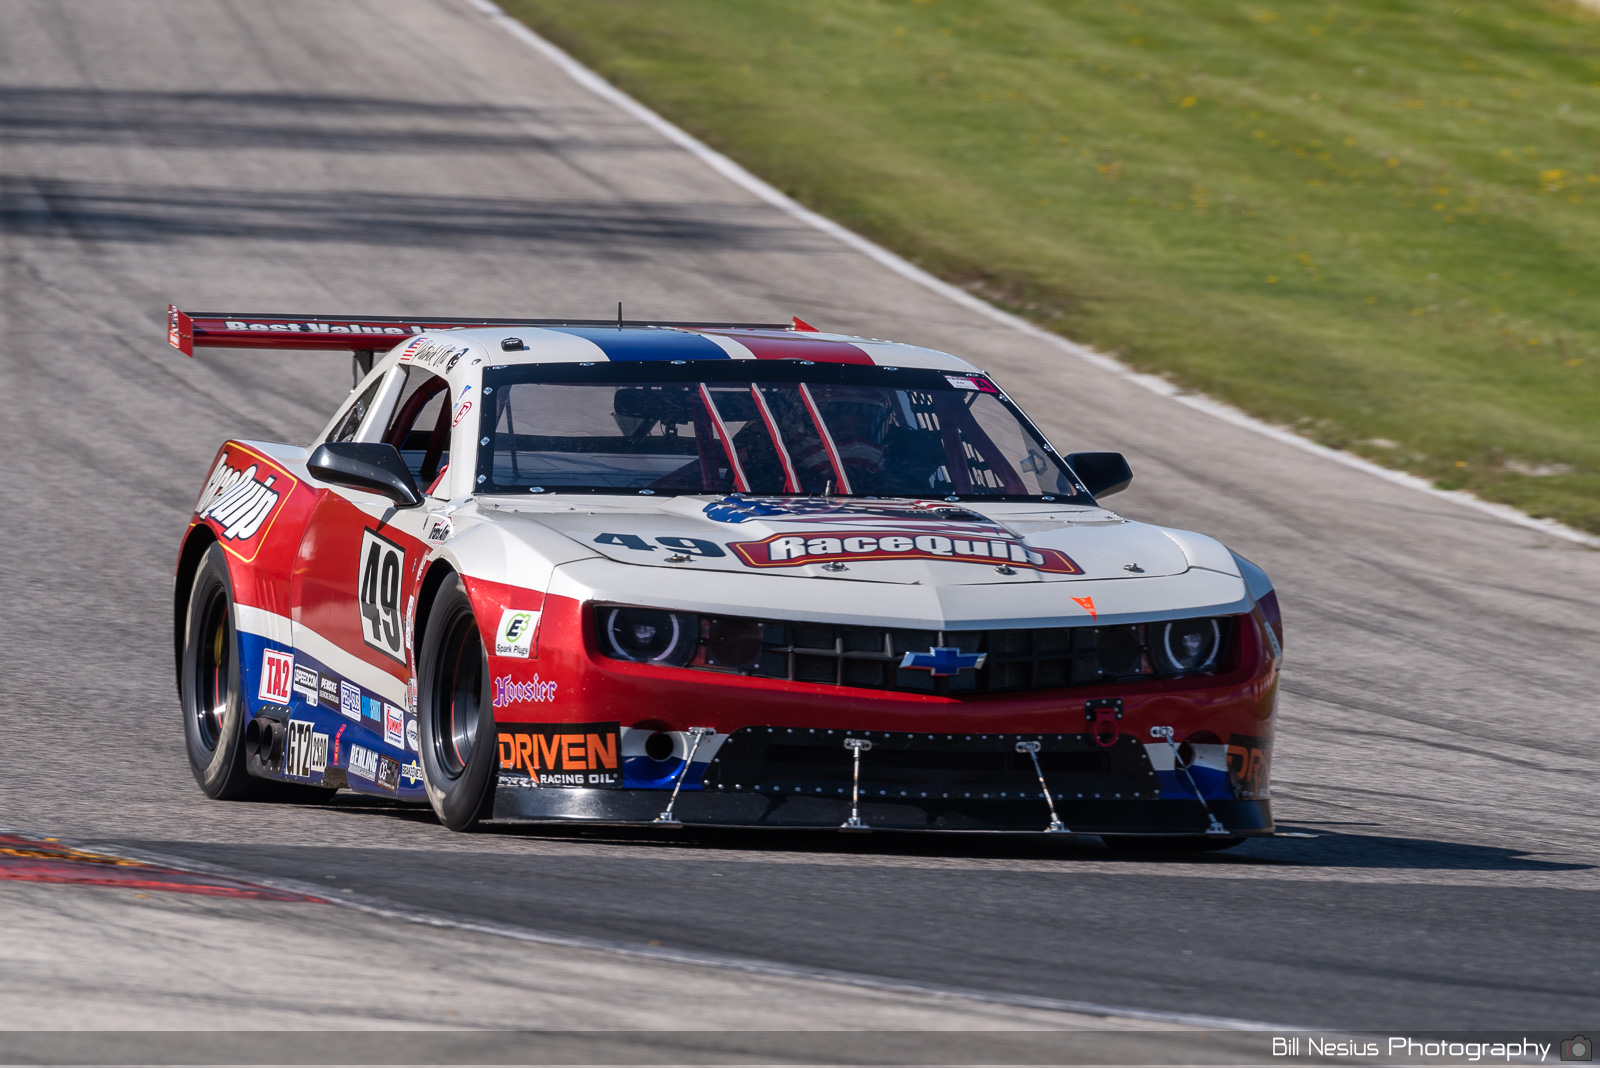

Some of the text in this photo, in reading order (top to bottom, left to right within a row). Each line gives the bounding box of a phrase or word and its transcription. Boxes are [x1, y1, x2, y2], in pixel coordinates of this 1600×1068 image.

[224, 320, 302, 332] Best
[306, 322, 405, 335] Value
[593, 532, 726, 558] 49
[768, 534, 1046, 566] RaceQuip
[361, 541, 400, 652] 49
[496, 643, 529, 657] Spark Plugs
[266, 657, 290, 698] TA2
[493, 673, 558, 707] Hoosier
[287, 721, 311, 776] GT2
[349, 744, 379, 773] BEHLING
[498, 732, 618, 783] DRIVEN
[540, 774, 584, 784] RACING
[589, 774, 615, 784] OIL
